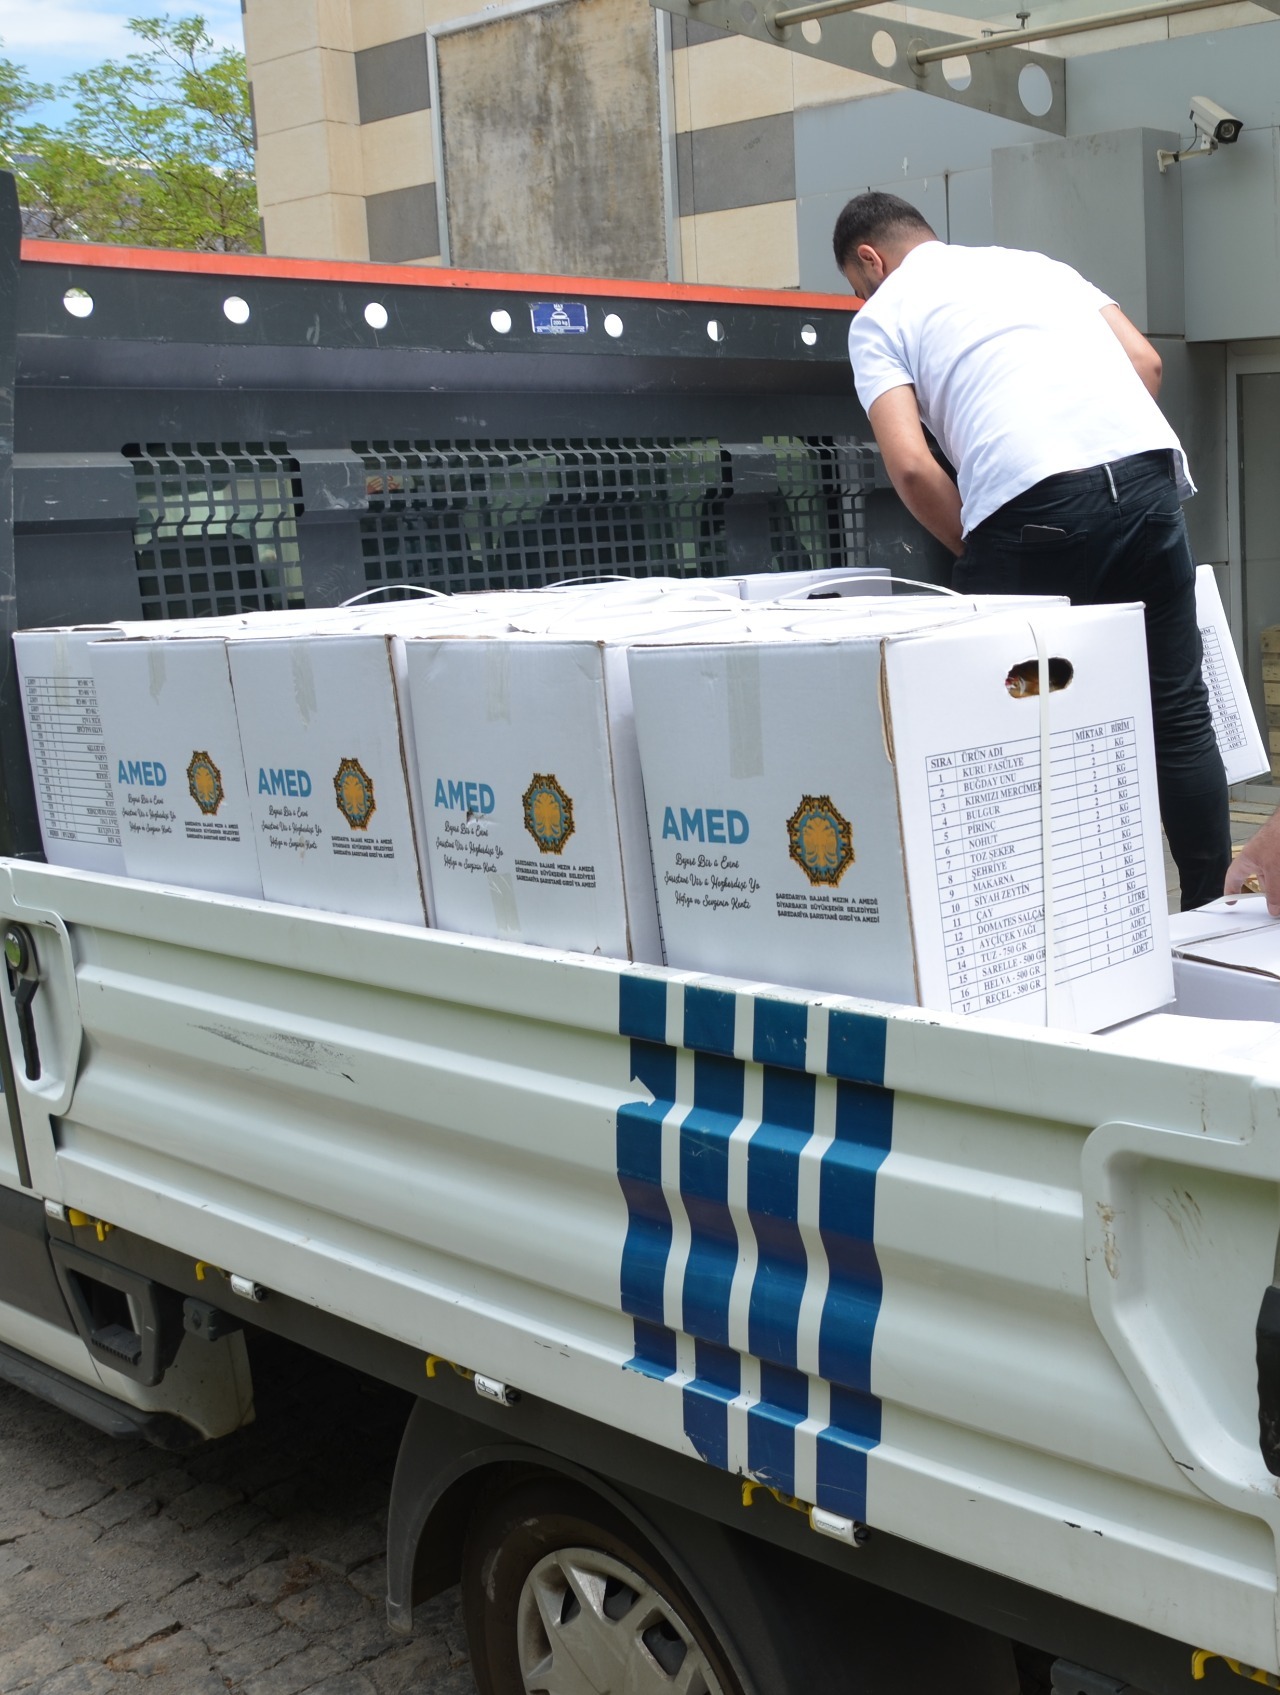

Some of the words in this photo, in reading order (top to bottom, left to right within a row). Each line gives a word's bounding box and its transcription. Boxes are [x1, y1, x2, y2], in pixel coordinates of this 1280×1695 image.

[931, 757, 952, 768] SIRA
[961, 748, 986, 763] ÜRÜN
[988, 747, 1003, 758] ADI
[1075, 727, 1104, 741] MİKTAR
[1110, 721, 1130, 733] BİRİM
[939, 774, 943, 783] 1
[962, 764, 987, 778] KURU
[988, 757, 1024, 773] FASÜLYE
[1091, 743, 1095, 752] 2
[1114, 737, 1124, 747] KG
[118, 760, 167, 787] AMED
[258, 768, 312, 797] AMED
[434, 778, 495, 815] AMED
[940, 788, 945, 798] 2
[963, 776, 998, 792] BUĞDAY
[999, 772, 1017, 785] UNU
[1092, 757, 1096, 766] 2
[1115, 750, 1125, 760] KG
[941, 802, 946, 812] 3
[965, 792, 999, 806] KIRMIZI
[1093, 770, 1097, 779] 2
[1116, 763, 1126, 773] KG
[662, 806, 750, 845] AMED
[942, 817, 947, 827] 4
[966, 805, 1001, 821] BULGUR
[1094, 784, 1098, 793] 2
[1117, 776, 1127, 786] KG
[943, 831, 949, 841] 5
[967, 820, 996, 835] PİRİNÇ
[1095, 797, 1099, 806] 2
[1118, 789, 1128, 799] KG
[945, 846, 950, 856] 6
[968, 834, 998, 849] NOHUT
[1096, 810, 1100, 820] 2
[1119, 802, 1129, 812] KG
[946, 860, 951, 870] 7
[969, 852, 988, 864] TOZ
[989, 844, 1015, 861] ŞEKER
[1097, 824, 1101, 833] 2
[1120, 815, 1130, 825] KG
[948, 875, 953, 884] 8
[971, 861, 1008, 881] ŞEHRİYE
[1098, 837, 1102, 847] 1
[1121, 828, 1131, 839] KG
[949, 889, 955, 899] 9
[973, 874, 1015, 892] MAKARNA
[1099, 851, 1103, 860] 1
[1122, 841, 1132, 852] KG
[951, 903, 960, 913] 10
[974, 891, 1000, 907] SİYAH
[1001, 882, 1030, 900] ZEYTİN
[1100, 864, 1104, 873] 1
[1123, 855, 1134, 865] KG
[952, 918, 962, 927] 11
[976, 908, 994, 923] ÇAY
[1101, 878, 1105, 887] 1
[1125, 868, 1135, 878] KG
[954, 931, 963, 942] 12
[977, 916, 1017, 935] DOMATES
[1017, 907, 1045, 923] SALÇAS
[1102, 890, 1107, 900] 3
[1126, 881, 1136, 891] KG
[956, 945, 965, 956] 13
[979, 931, 1016, 950] AYÇİÇEK
[1017, 924, 1037, 938] YAĞI
[1103, 904, 1108, 913] 5
[1127, 889, 1146, 904] LİTRE
[957, 960, 967, 970] 14
[981, 951, 997, 963] TUZ
[1003, 945, 1015, 957] 750
[1015, 941, 1027, 952] GR
[1105, 917, 1108, 926] 1
[1129, 904, 1145, 917] ADET
[959, 974, 968, 984] 15
[982, 958, 1018, 977] SARELLE
[1023, 953, 1035, 965] 500
[1035, 948, 1046, 960] GR
[1105, 930, 1109, 939] 1
[1130, 916, 1146, 930] ADET
[960, 988, 970, 998] 16
[983, 976, 1011, 991] HELVA
[1016, 969, 1028, 980] 500
[1029, 965, 1041, 976] GR
[1106, 943, 1110, 952] 1
[1131, 929, 1148, 943] ADET
[962, 1002, 971, 1013] 17
[985, 989, 1012, 1005] REÇEL
[1016, 983, 1028, 995] 380
[1029, 979, 1041, 990] GR
[1107, 956, 1111, 965] 1
[1132, 942, 1149, 956] ADET
